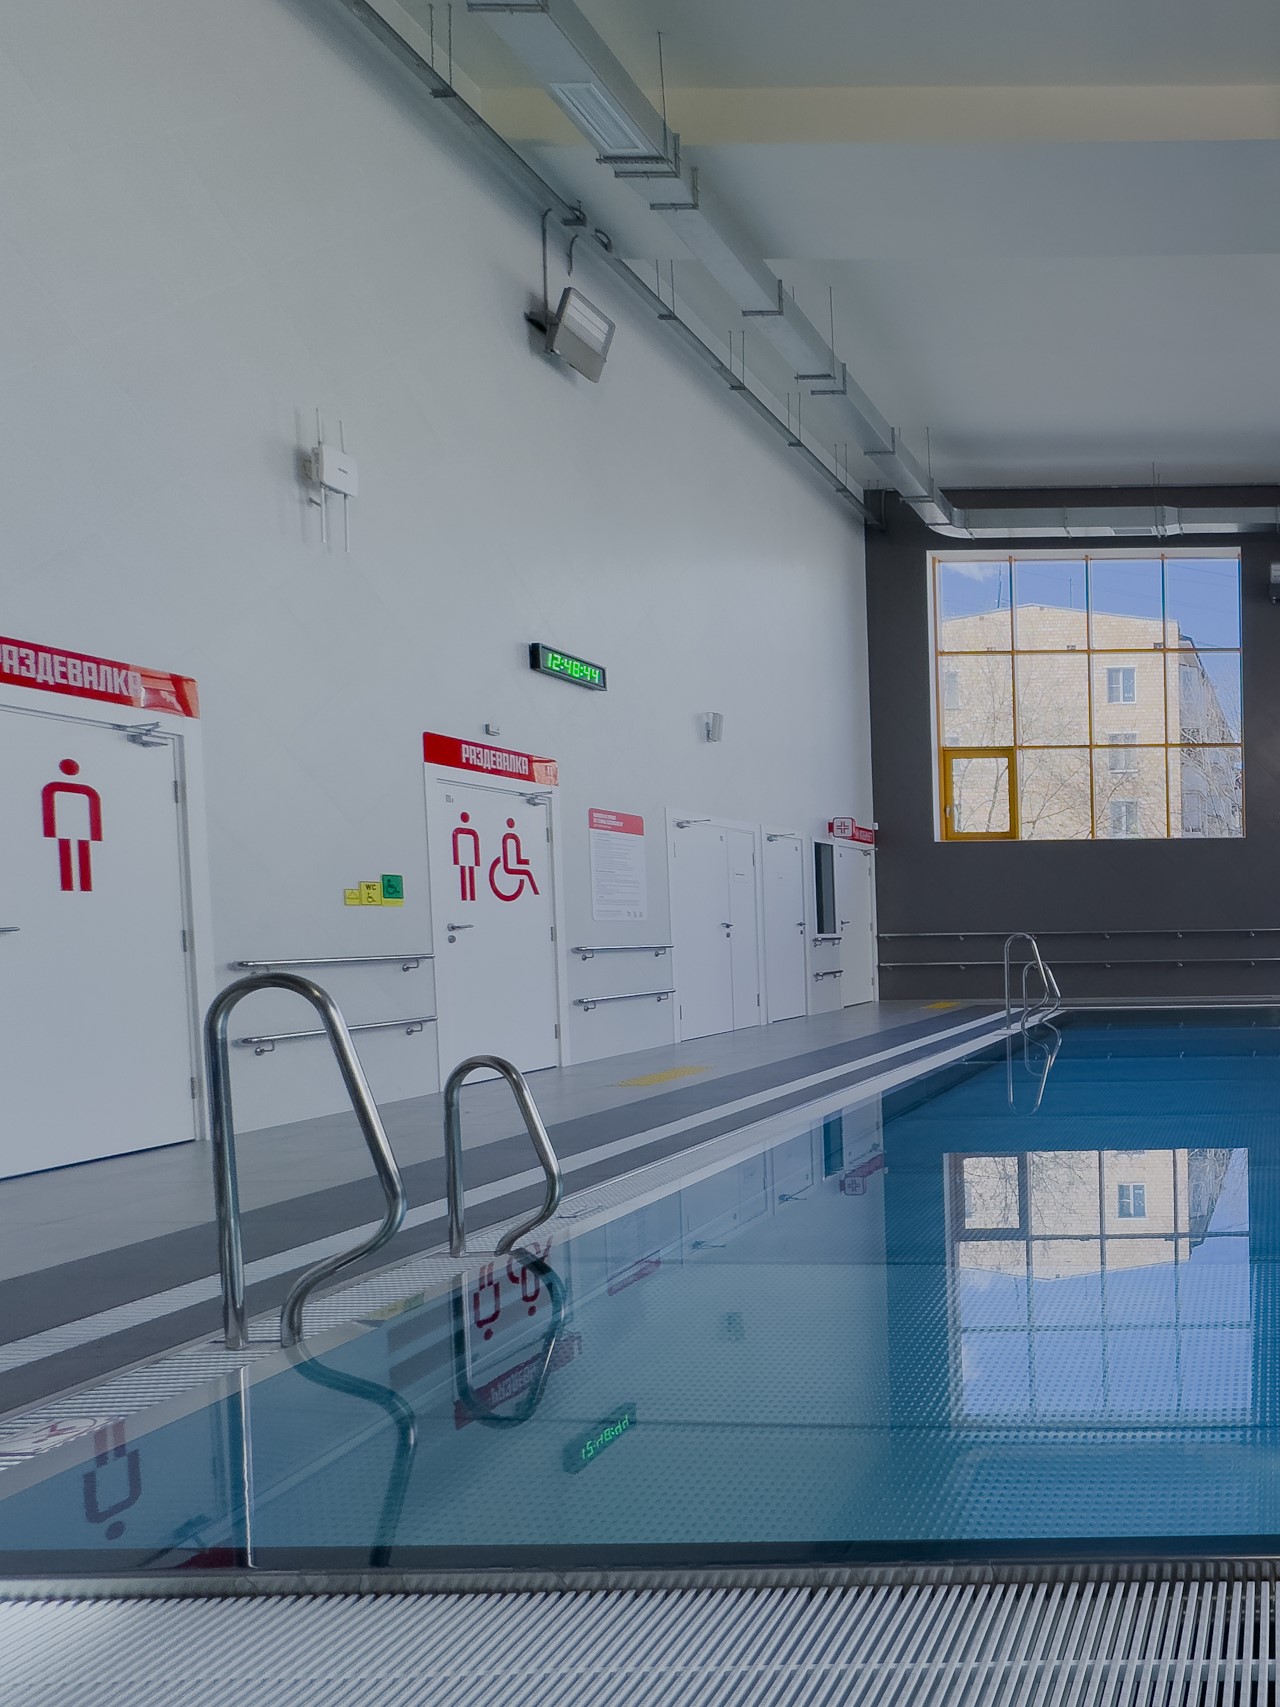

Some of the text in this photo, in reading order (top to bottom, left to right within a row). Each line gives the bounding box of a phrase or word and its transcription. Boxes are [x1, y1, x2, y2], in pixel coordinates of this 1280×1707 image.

[0, 644, 142, 698] АЗДЕВАЛКА
[547, 653, 600, 684] 12:48:44
[461, 744, 529, 775] РАЗДЕВАЛКА
